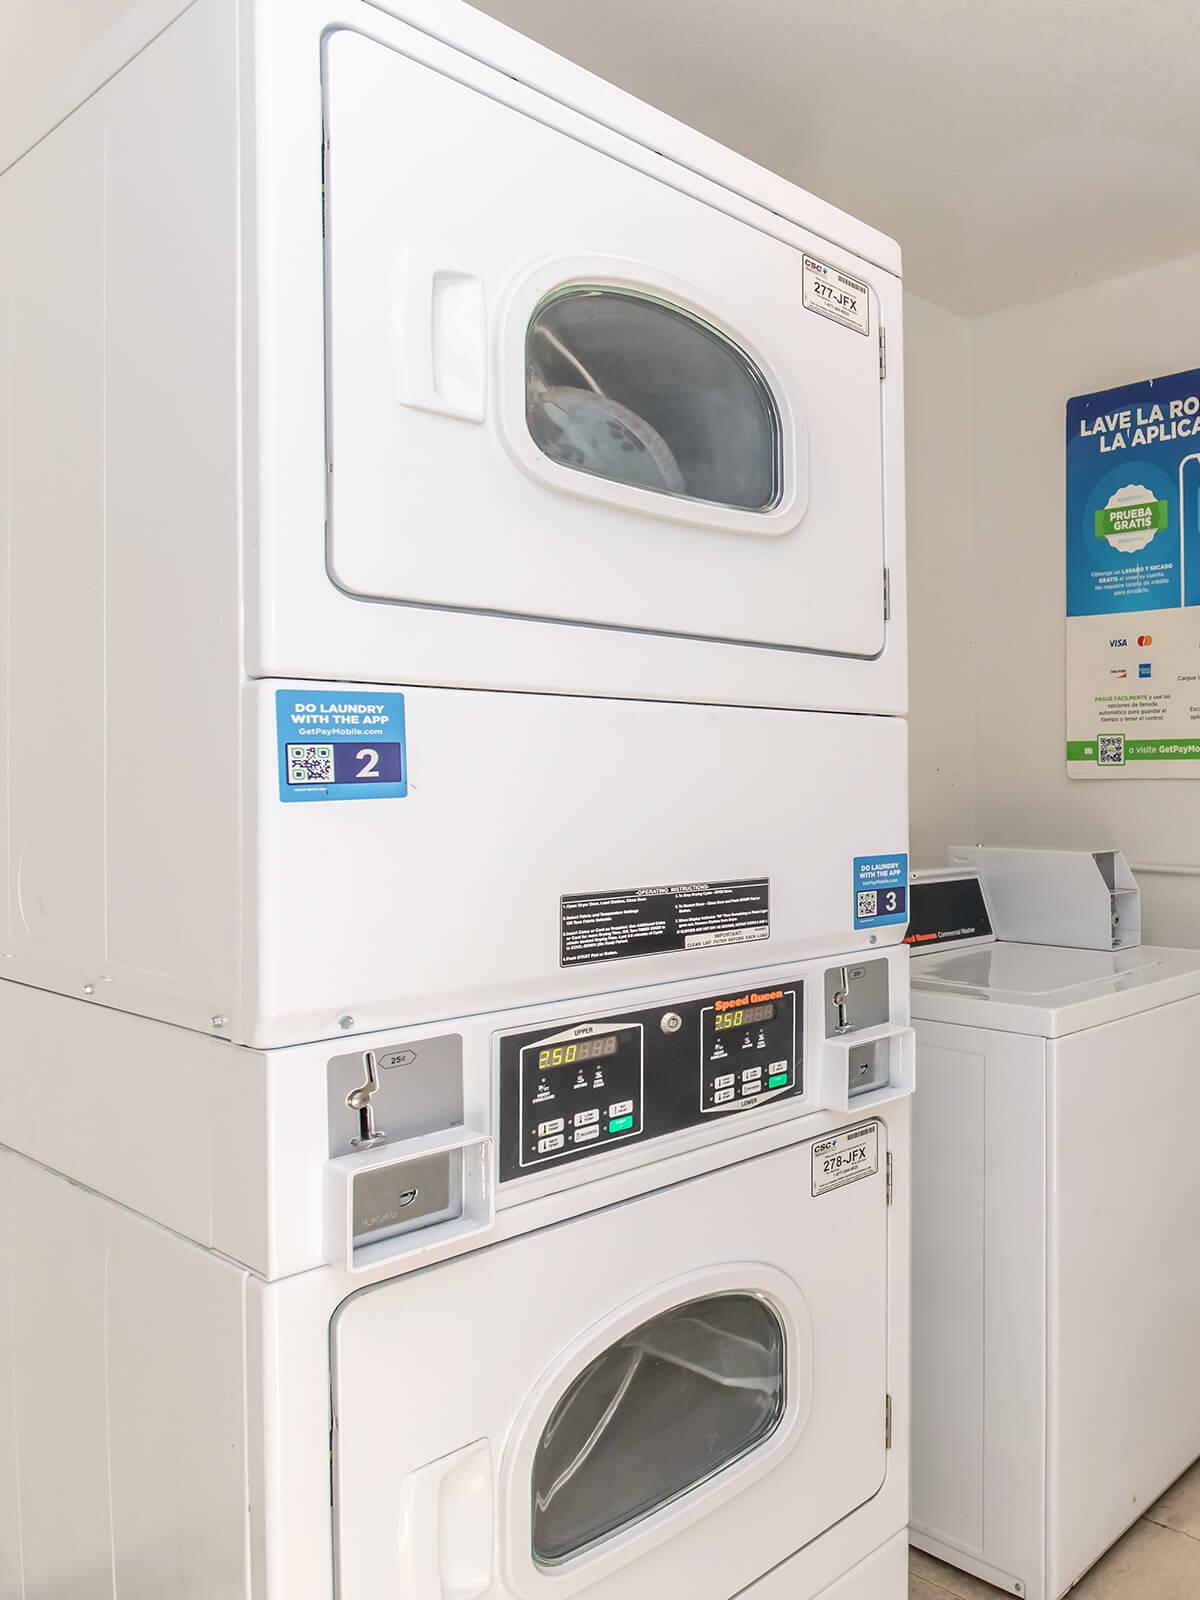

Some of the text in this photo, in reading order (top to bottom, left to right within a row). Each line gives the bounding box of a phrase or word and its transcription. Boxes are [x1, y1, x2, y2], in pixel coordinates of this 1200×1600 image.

[805, 259, 823, 272] CSC
[814, 281, 857, 312] 277-JFX
[1080, 410, 1131, 437] LAVE
[1137, 404, 1164, 426] LA
[1100, 431, 1126, 454] LA
[1110, 506, 1152, 521] PRUEBA
[1114, 517, 1151, 530] GRATIS
[1109, 639, 1128, 647] VISA
[295, 704, 385, 714] DO LAUNDRY
[291, 715, 389, 724] WITH THE APP
[298, 728, 383, 736] GetPayMobile.com
[1136, 745, 1158, 754] visite
[355, 748, 380, 778] 2
[871, 863, 899, 871] LAUNDRY
[886, 892, 897, 911] 3
[715, 990, 783, 1011] Speed Queen
[574, 1027, 593, 1036] UPPER
[741, 1098, 757, 1107] LOWER
[814, 1142, 831, 1152] CSC
[823, 1147, 865, 1172] 278-JFX
